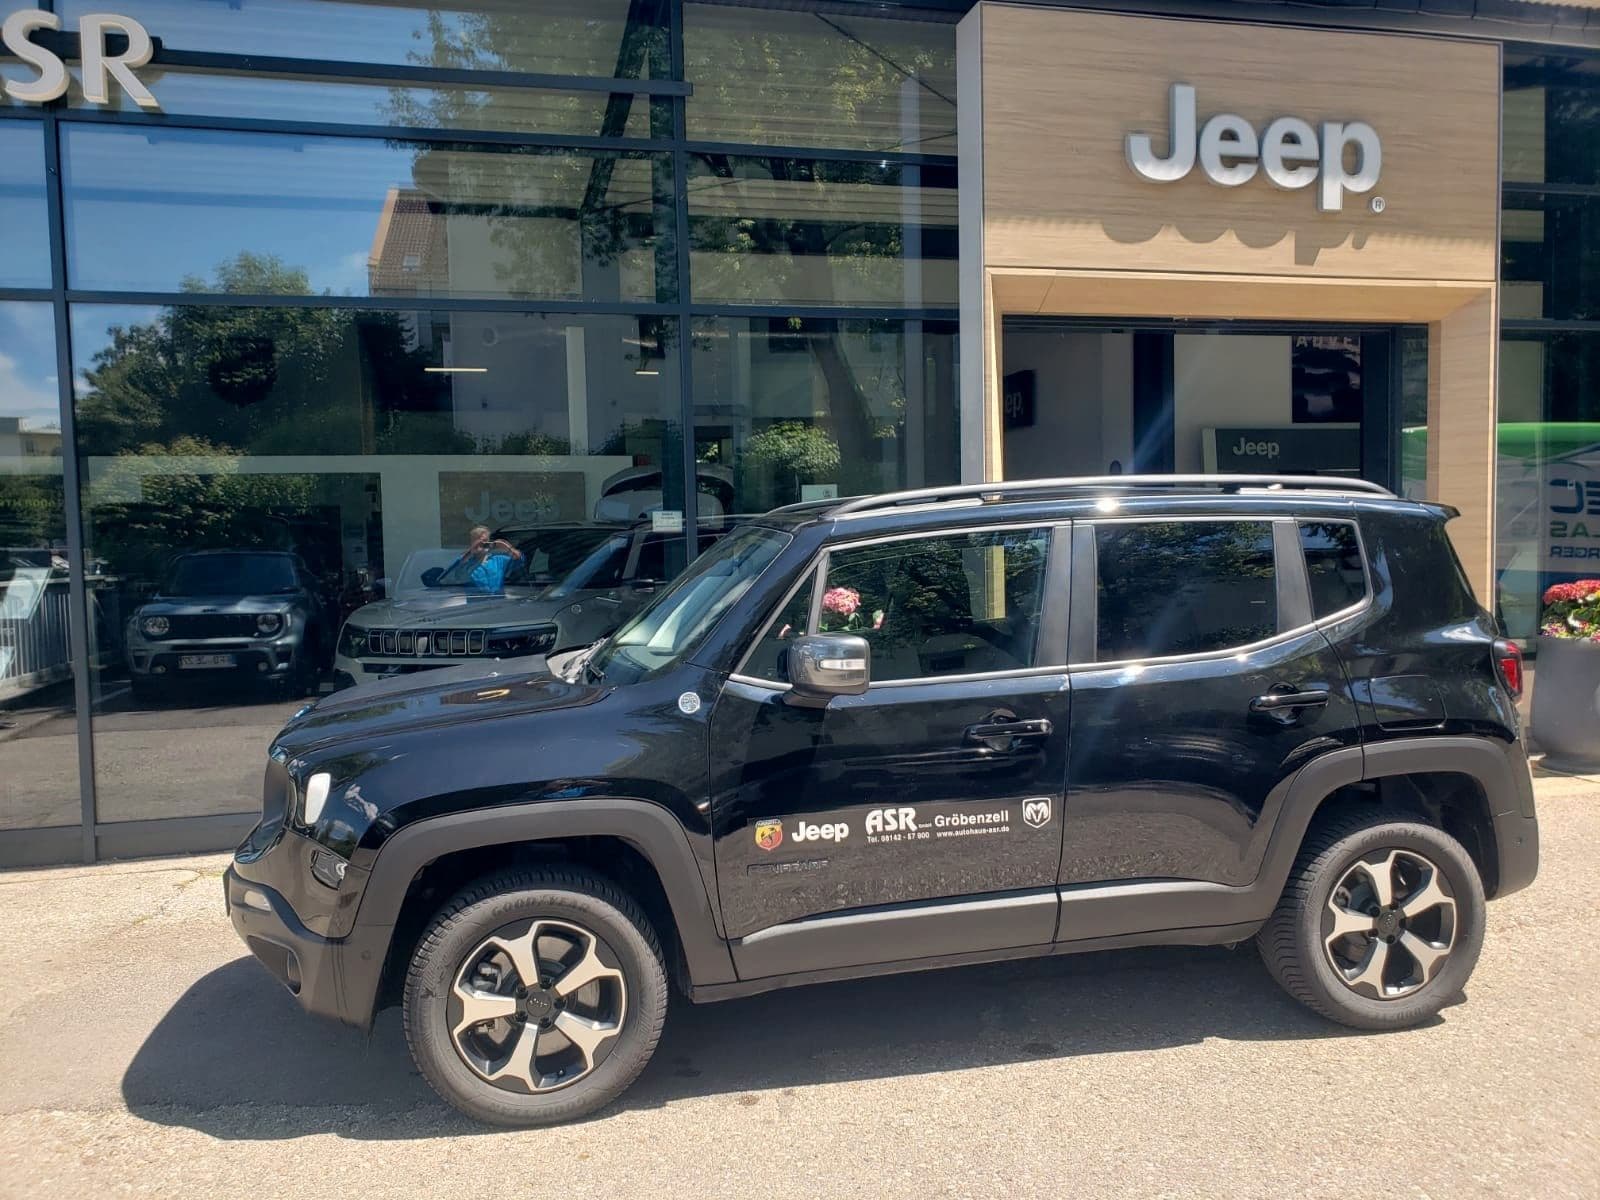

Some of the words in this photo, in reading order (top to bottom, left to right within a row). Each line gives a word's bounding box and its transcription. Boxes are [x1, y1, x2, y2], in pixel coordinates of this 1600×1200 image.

[1125, 81, 1382, 212] Jeep
[1232, 437, 1280, 459] Jeep
[791, 821, 850, 842] Jeep
[865, 807, 918, 835] ASR
[934, 810, 1009, 828] Gröbenzell
